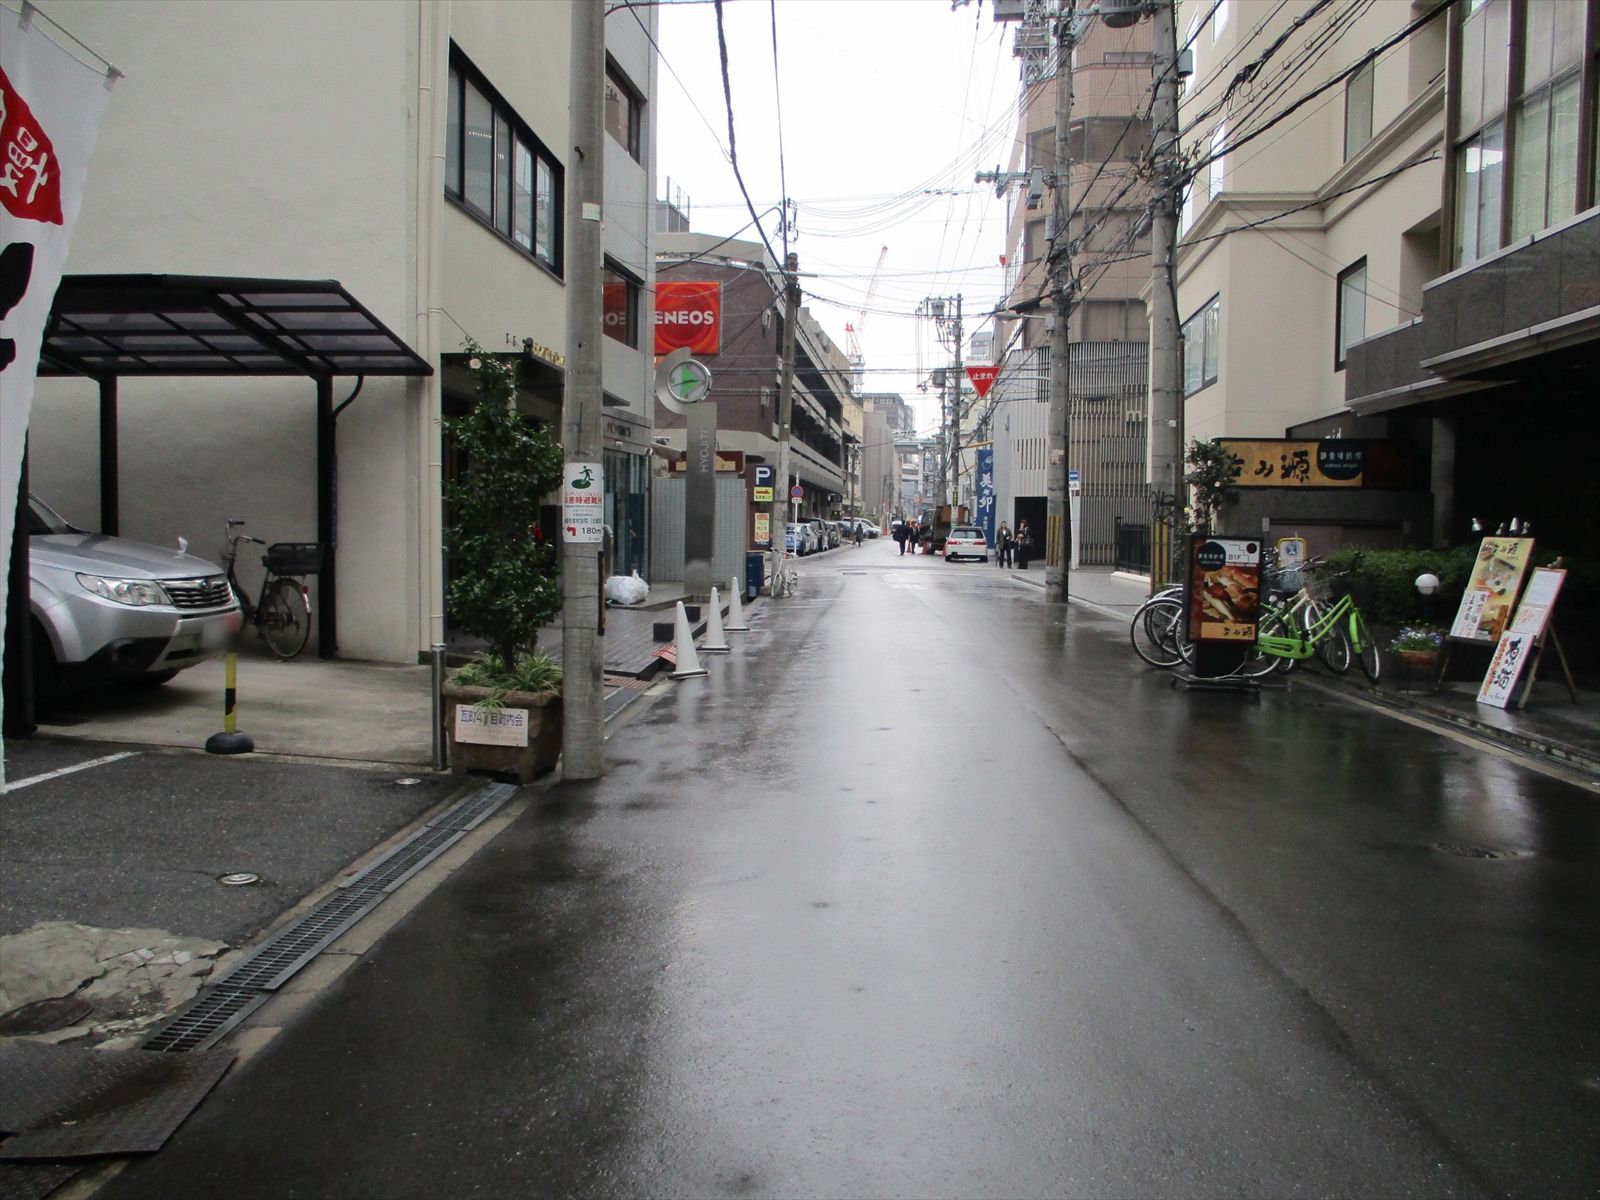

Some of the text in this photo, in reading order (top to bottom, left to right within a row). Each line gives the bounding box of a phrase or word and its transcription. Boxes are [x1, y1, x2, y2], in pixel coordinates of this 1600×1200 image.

[655, 310, 714, 325] ENEOS
[972, 372, 994, 380] 止まれ
[699, 424, 710, 473] HYOJITO
[755, 466, 771, 485] P
[980, 471, 993, 513] 美々卯
[1228, 553, 1241, 561] B1F
